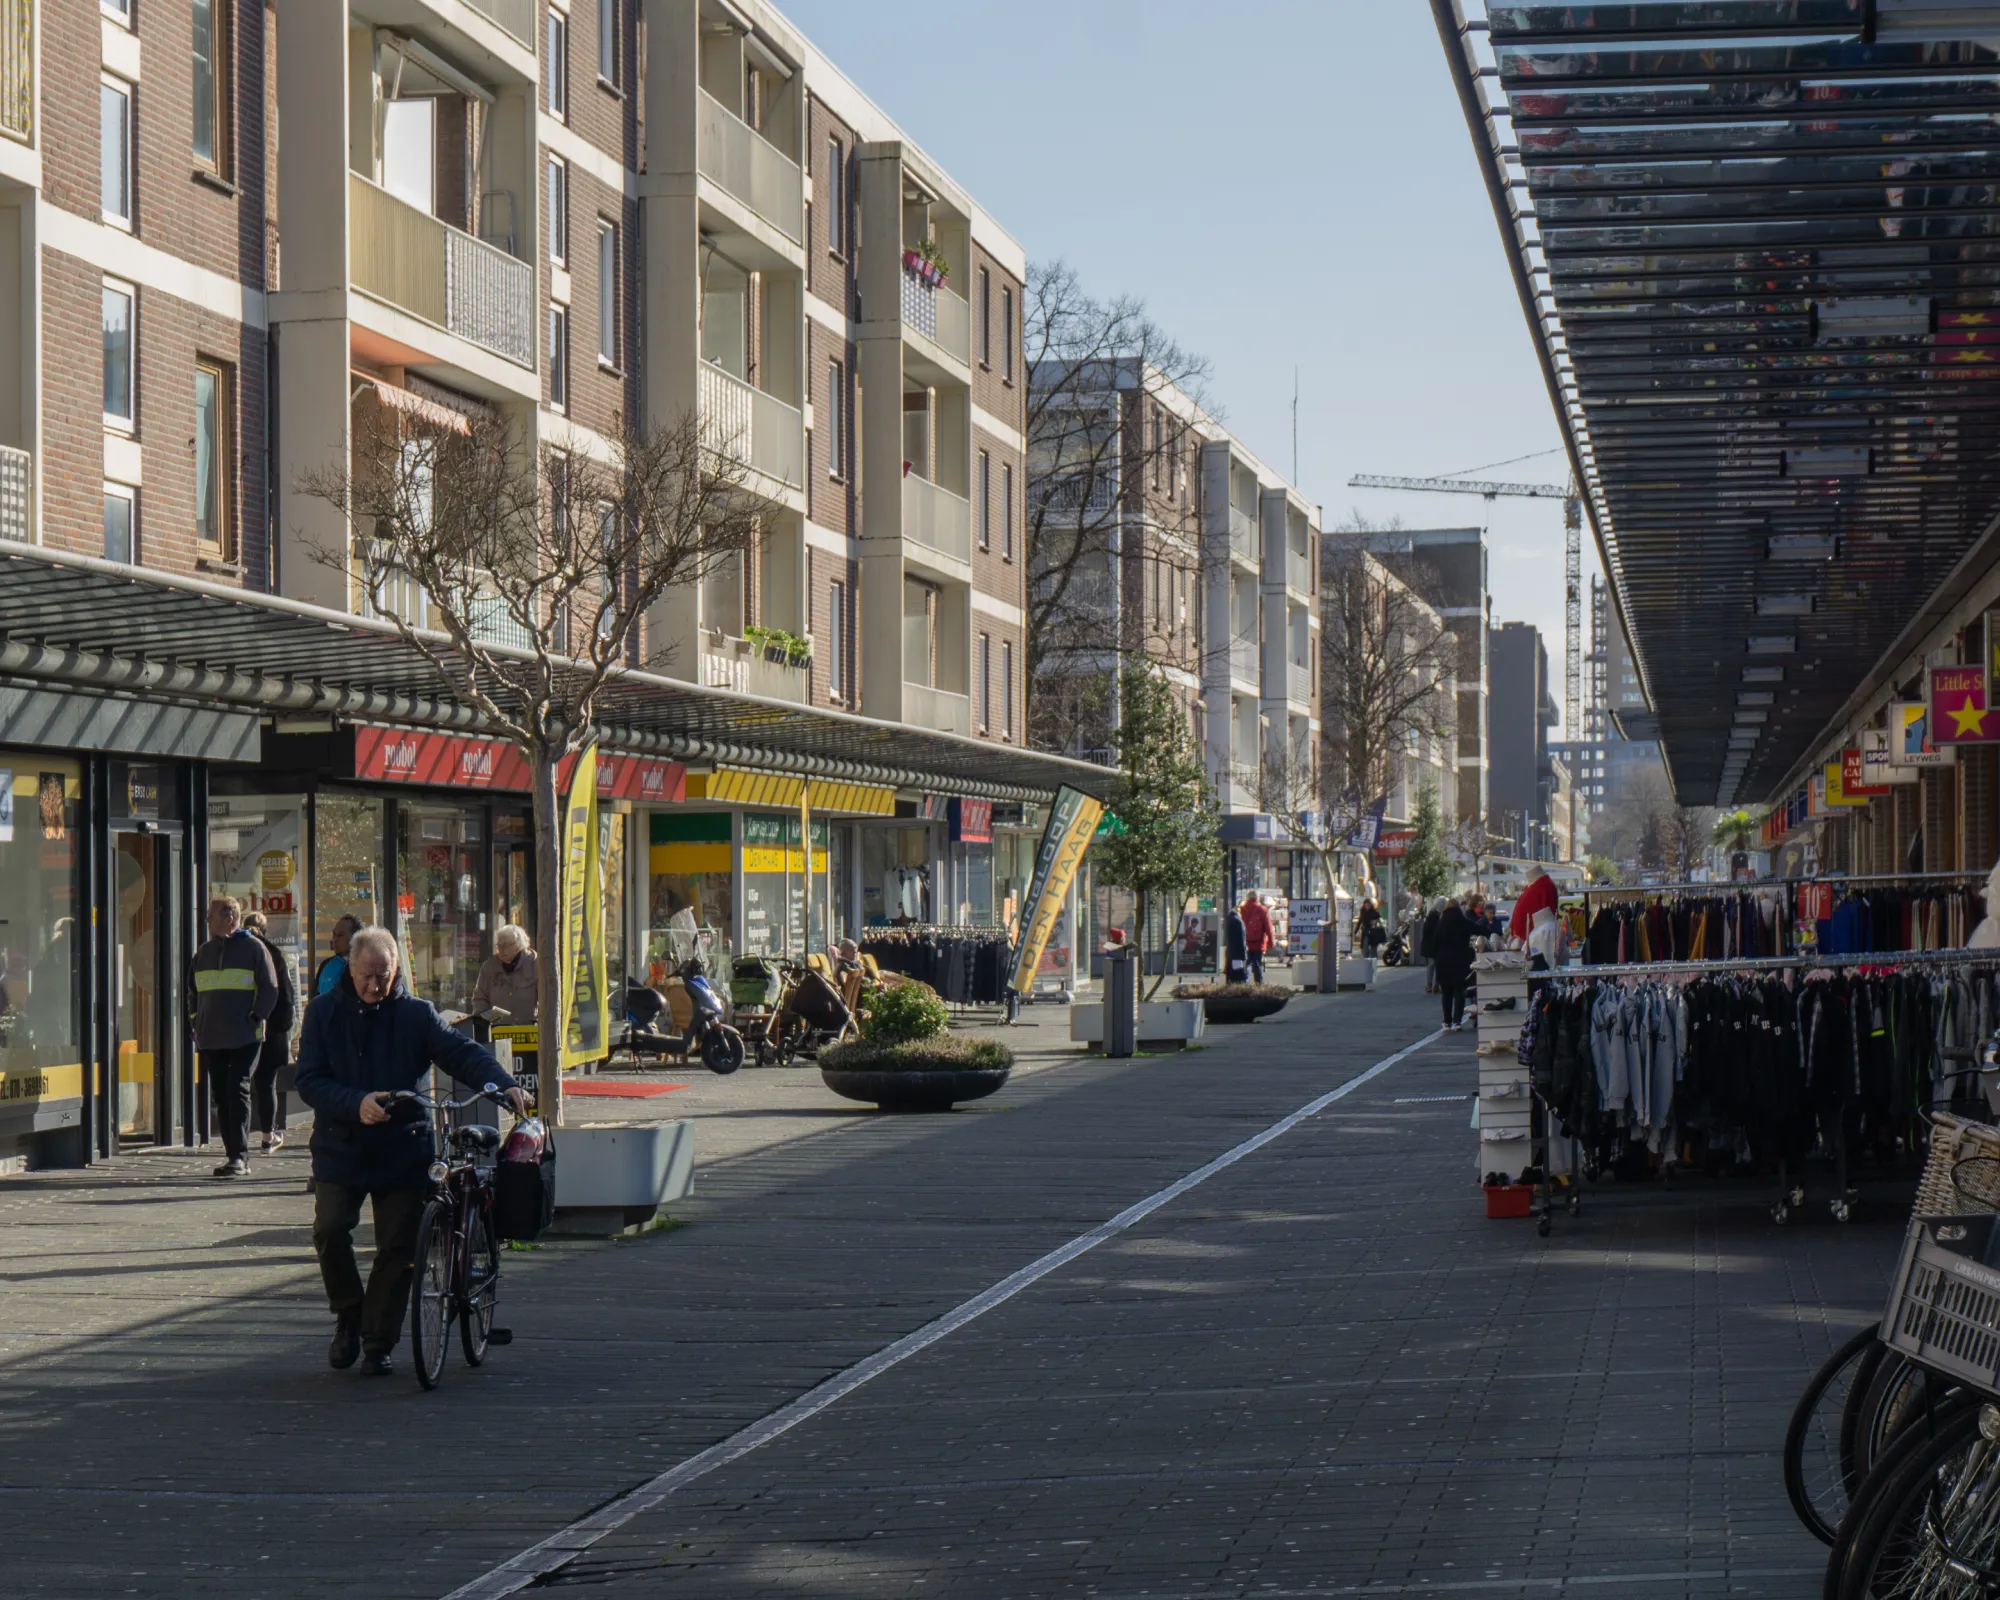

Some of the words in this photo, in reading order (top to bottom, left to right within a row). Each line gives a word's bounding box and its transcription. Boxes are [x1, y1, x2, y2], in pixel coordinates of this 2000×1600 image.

[1935, 673, 1970, 691] Little
[384, 740, 417, 768] roobol
[463, 748, 492, 774] roobol
[1867, 752, 1889, 761] SPOR
[1904, 755, 1941, 763] LEYWEG
[596, 762, 614, 785] oobol
[642, 767, 664, 789] roobol
[1378, 838, 1403, 848] olski
[261, 857, 289, 866] GRATIS
[1022, 909, 1049, 970] DEN
[1047, 818, 1092, 898] HAAG
[1300, 904, 1321, 913] INKT
